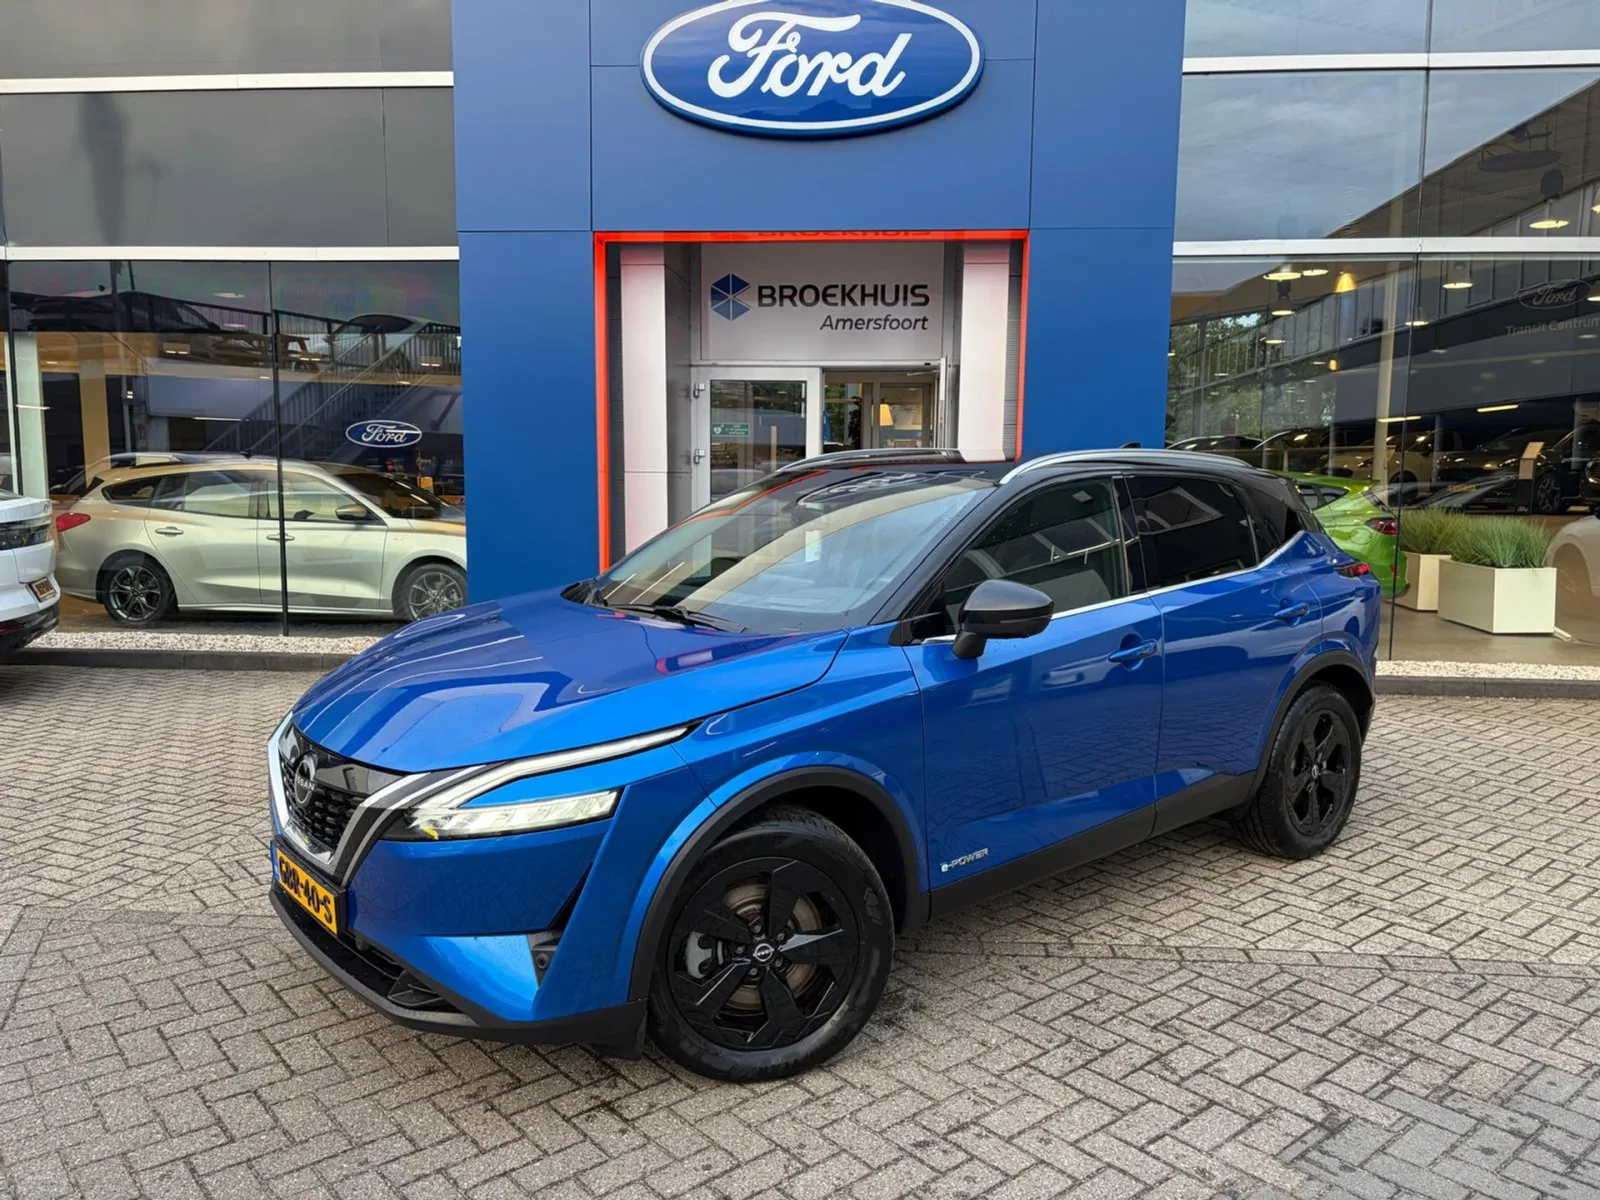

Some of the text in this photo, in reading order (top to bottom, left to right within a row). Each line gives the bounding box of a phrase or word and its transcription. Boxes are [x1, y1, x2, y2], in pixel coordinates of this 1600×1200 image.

[708, 11, 913, 98] Ford
[757, 284, 930, 308] BROEKHUIS
[1532, 285, 1579, 306] Ford
[820, 314, 929, 331] Amersfoort
[1506, 322, 1548, 336] Transit
[361, 423, 407, 443] Ford
[940, 847, 989, 872] e-POWER
